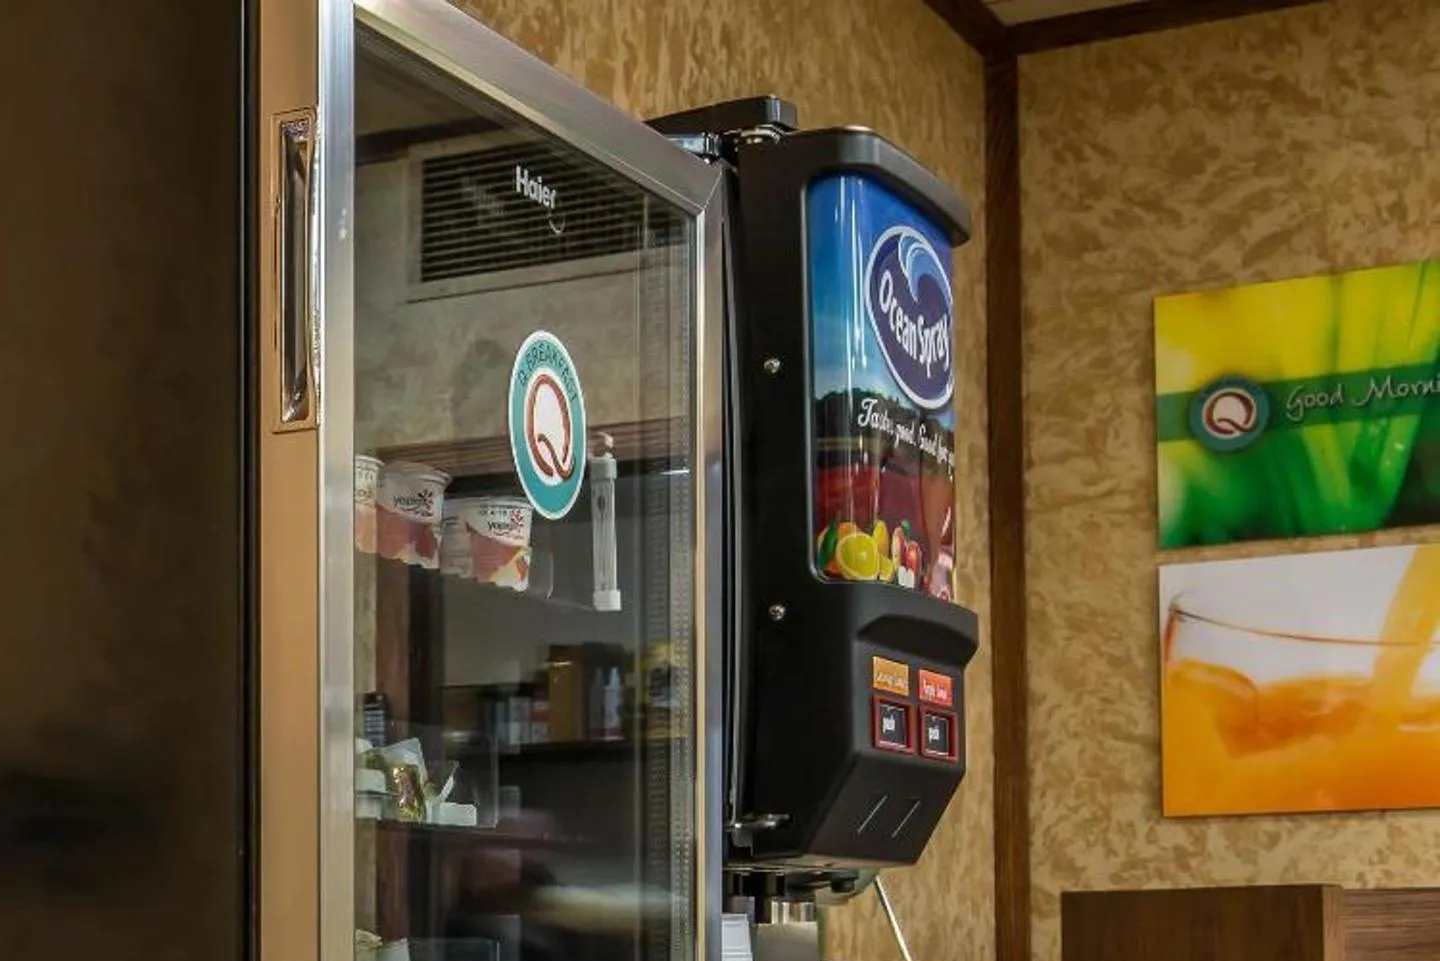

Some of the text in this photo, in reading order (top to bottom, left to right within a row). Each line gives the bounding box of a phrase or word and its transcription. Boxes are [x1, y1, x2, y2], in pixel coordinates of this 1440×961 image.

[515, 165, 557, 210] Haier
[879, 270, 950, 379] Ocean Spray
[1205, 391, 1255, 435] Q
[1286, 384, 1344, 422] Good
